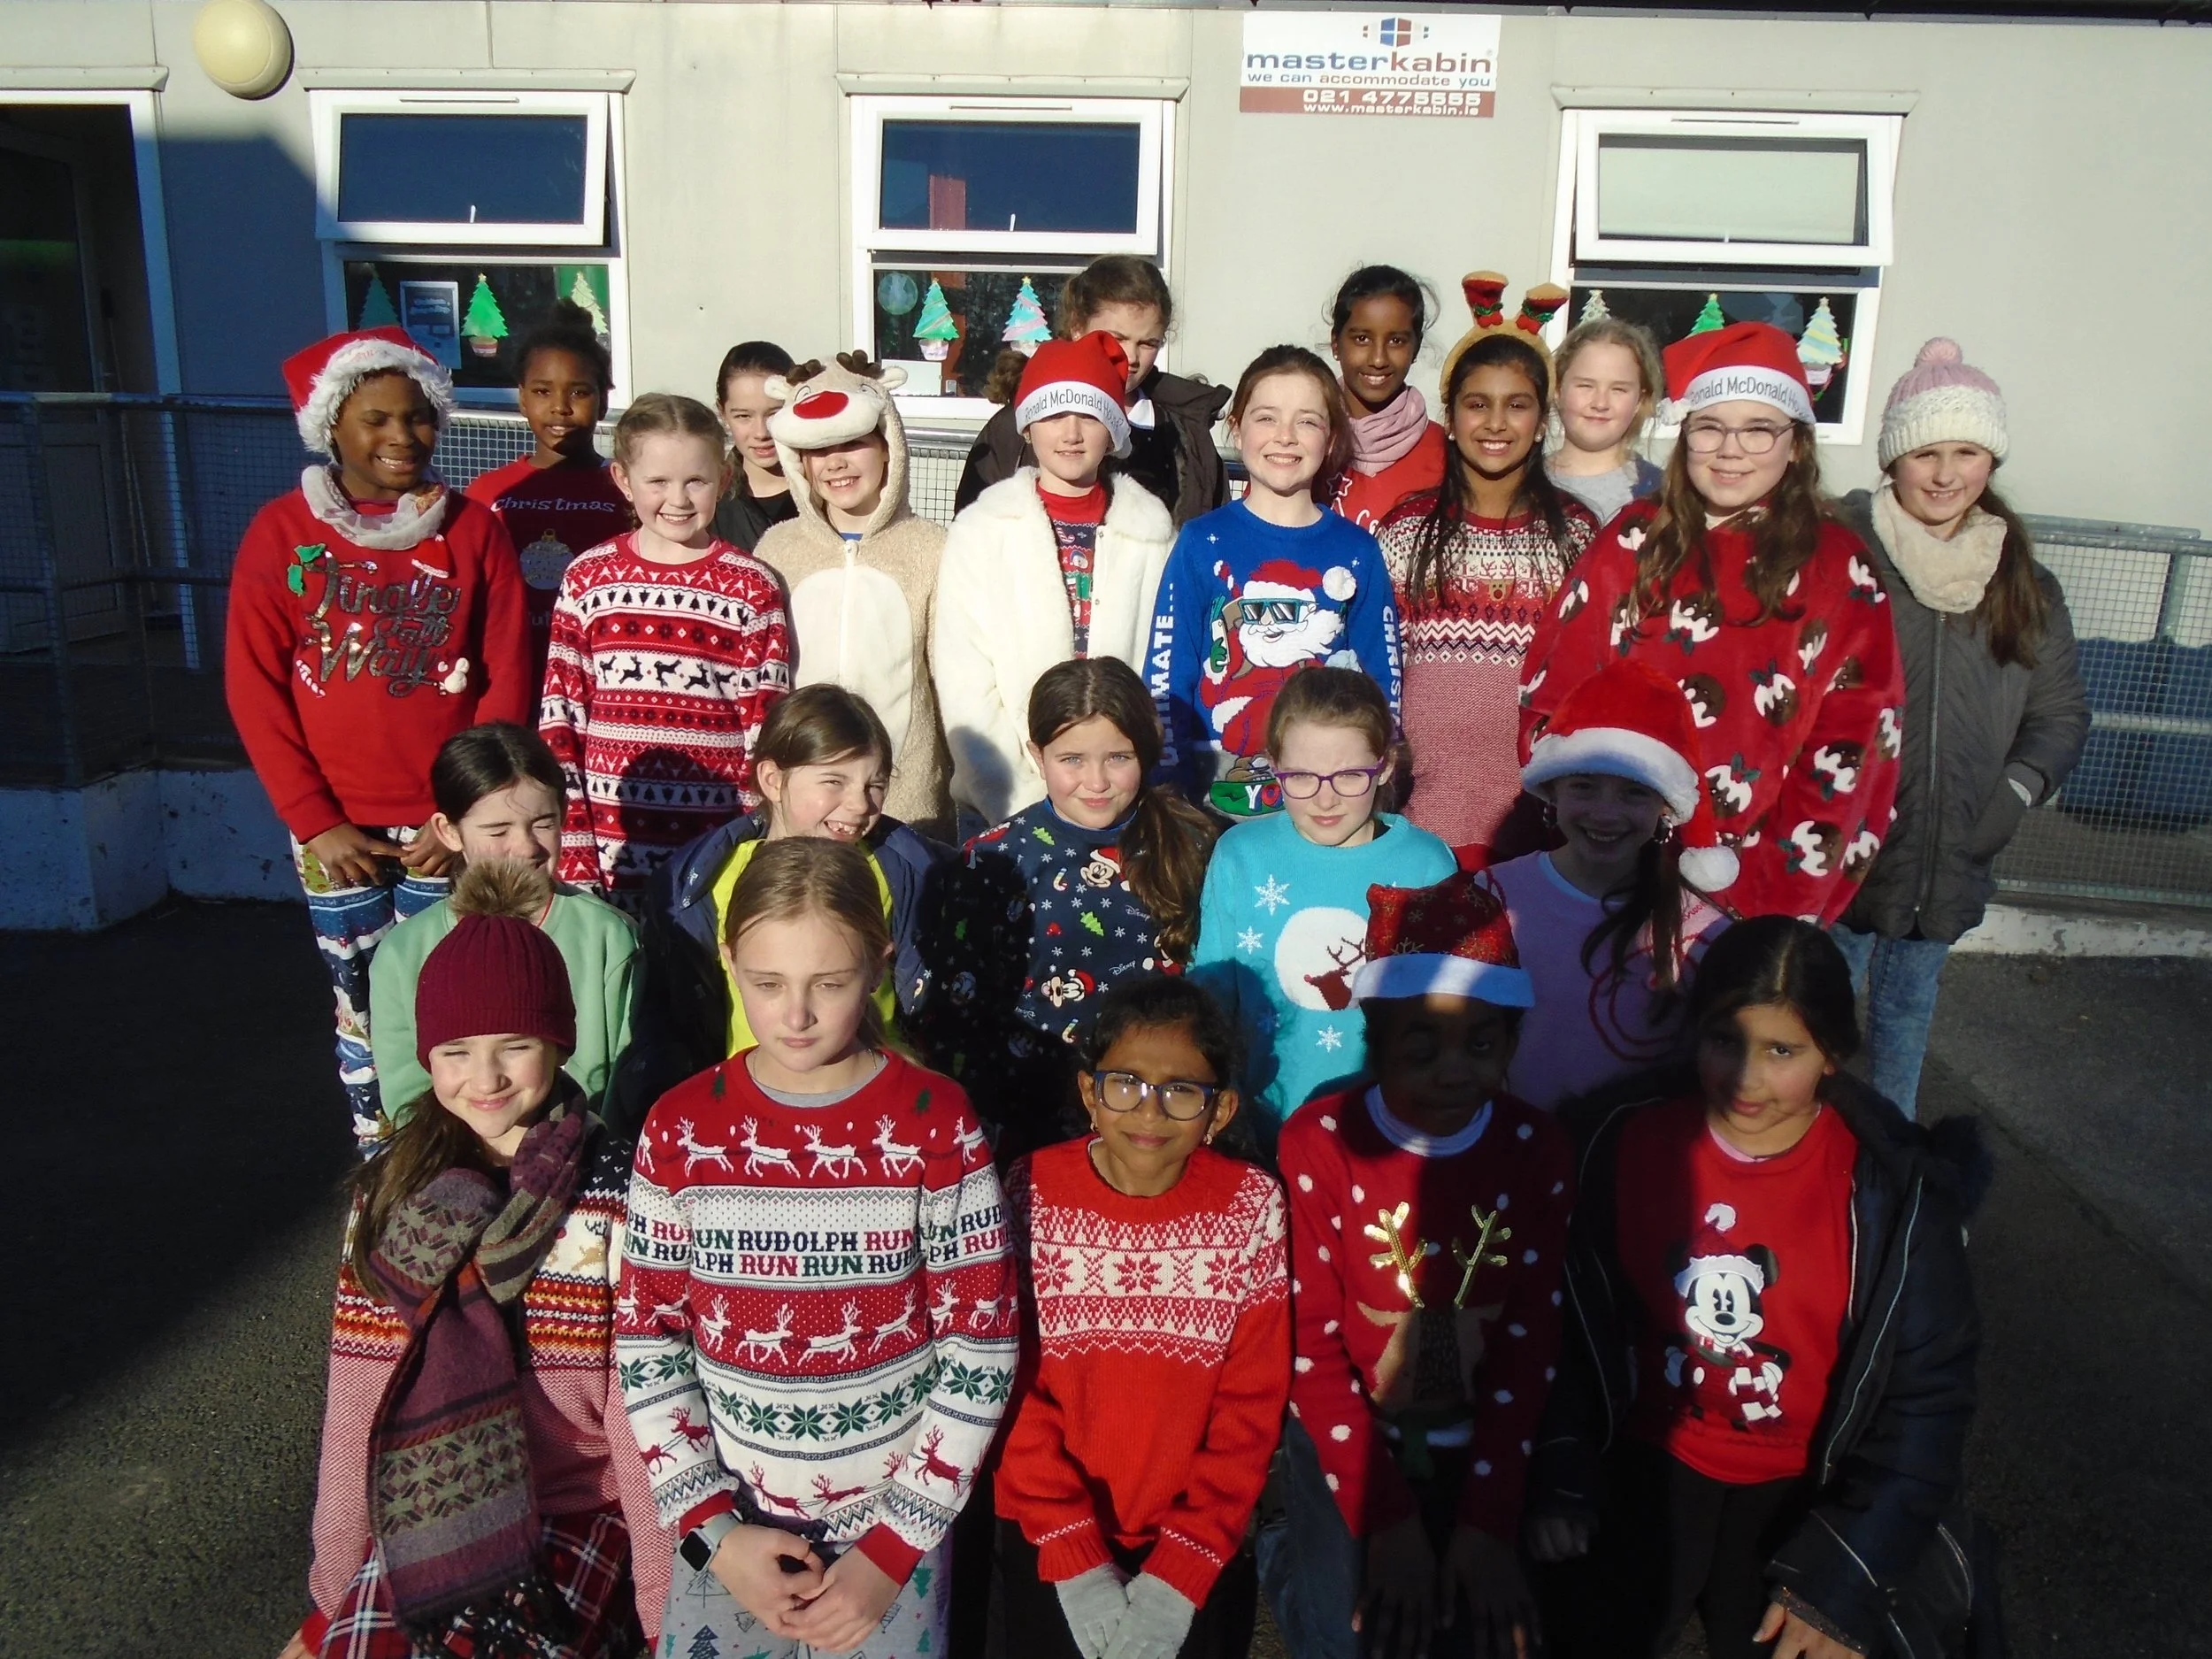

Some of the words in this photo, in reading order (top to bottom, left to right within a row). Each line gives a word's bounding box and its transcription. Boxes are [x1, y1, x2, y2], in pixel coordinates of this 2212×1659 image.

[1247, 51, 1491, 73] masterkabin
[1248, 73, 1272, 82] we
[1280, 73, 1312, 83] can
[1319, 74, 1450, 86] accommodate
[1459, 77, 1491, 88] you
[1302, 89, 1350, 104] 021
[1049, 388, 1102, 411] McDonald
[1726, 376, 1788, 405] McDonald
[305, 620, 439, 696] Way
[1244, 781, 1283, 810] YO
[1108, 960, 1136, 976] Disney
[652, 1240, 692, 1262] RU
[693, 1229, 734, 1250] UN
[738, 1229, 858, 1253] RUDOLPH
[739, 1254, 798, 1277] RUN
[802, 1255, 864, 1277] RUN
